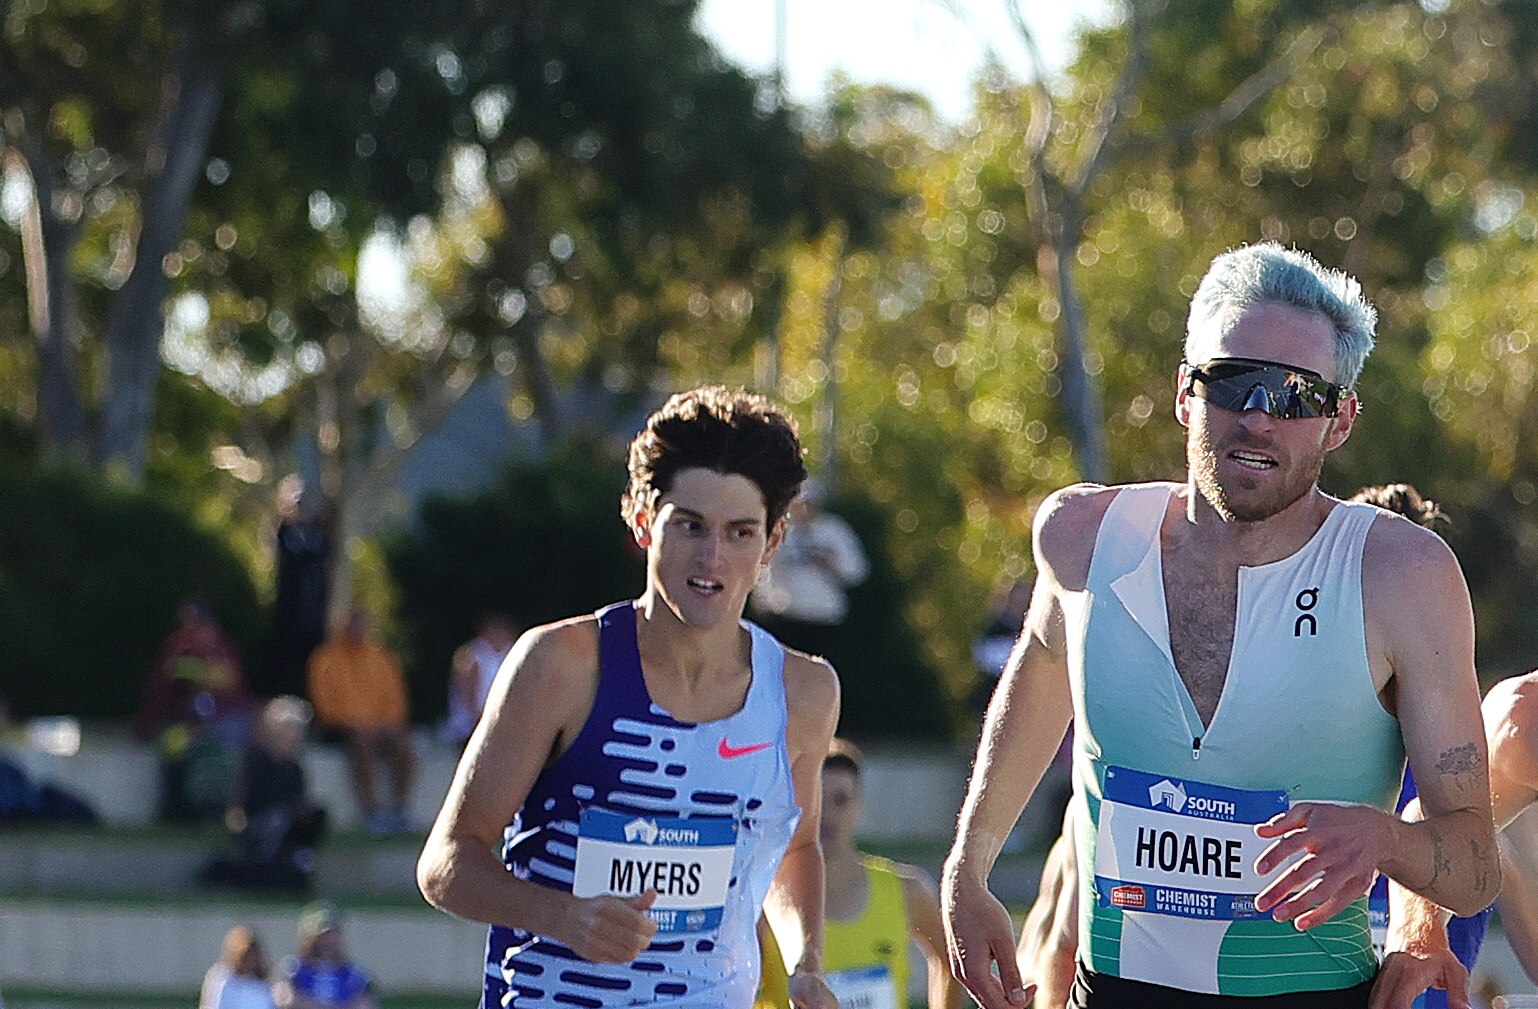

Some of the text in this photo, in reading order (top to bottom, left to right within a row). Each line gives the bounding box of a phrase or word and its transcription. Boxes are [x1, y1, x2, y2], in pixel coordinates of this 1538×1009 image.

[1187, 809, 1234, 821] AUSTRALIA
[1188, 796, 1235, 815] SOUTH
[659, 829, 699, 844] SOUTH
[1135, 827, 1242, 879] HOARE
[609, 858, 702, 895] MYERS
[1156, 889, 1218, 909] CHEMIST
[1156, 902, 1216, 916] WAREHOUSE
